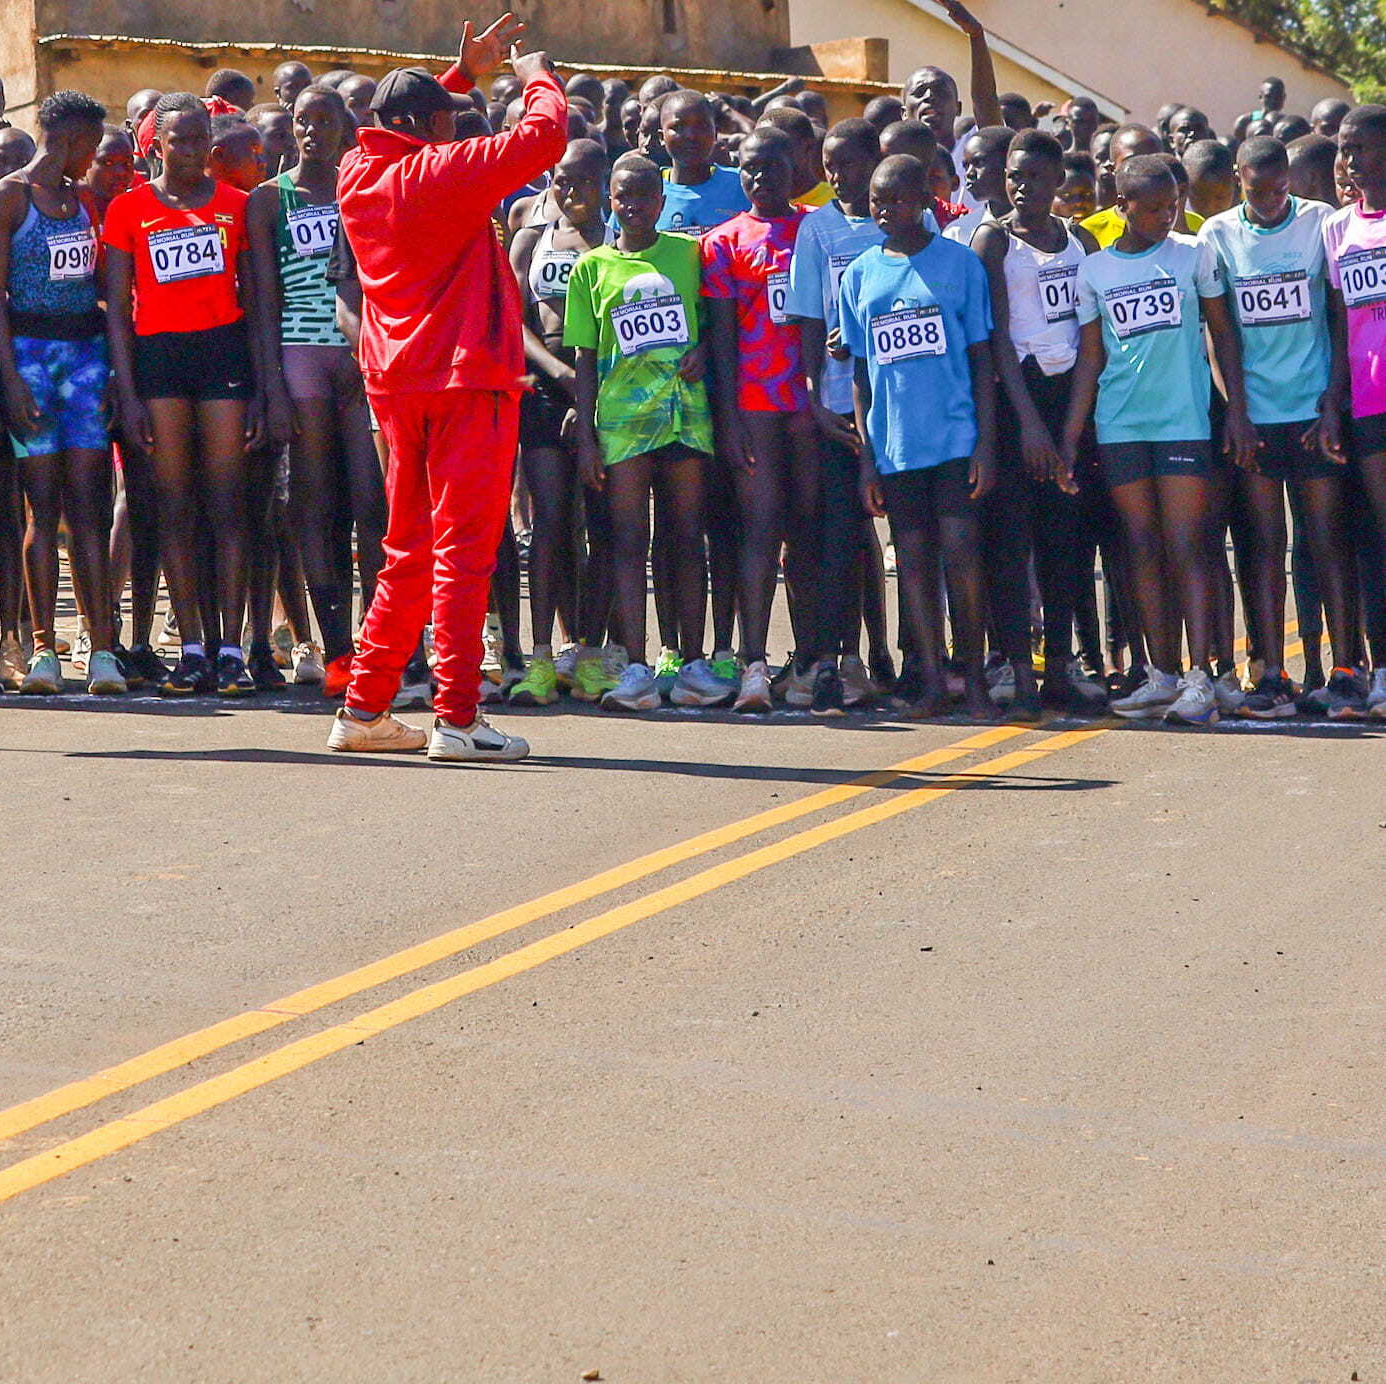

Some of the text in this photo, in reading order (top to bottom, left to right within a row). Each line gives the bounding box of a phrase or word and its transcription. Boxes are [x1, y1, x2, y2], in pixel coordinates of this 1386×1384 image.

[296, 218, 339, 245] 018
[154, 239, 218, 271] 0784
[542, 262, 571, 284] 08
[1045, 281, 1079, 308] 01
[1113, 291, 1175, 325] 0739
[1241, 285, 1302, 313] 0641
[620, 309, 682, 342] 0603
[877, 322, 940, 353] 0888
